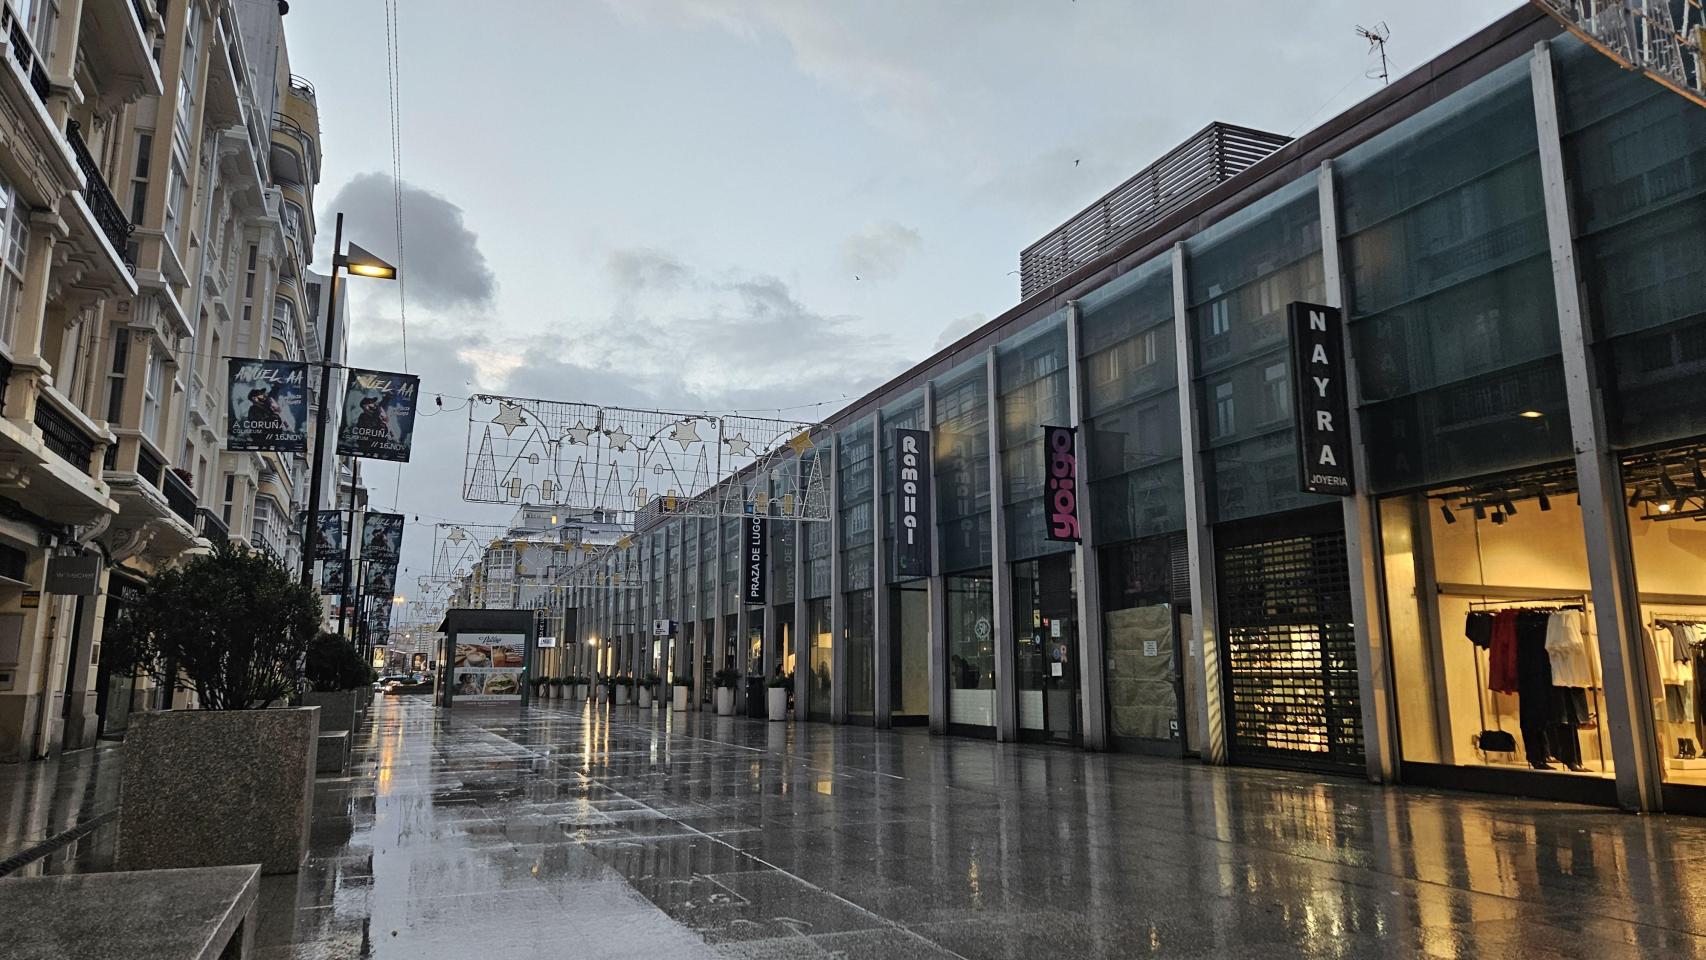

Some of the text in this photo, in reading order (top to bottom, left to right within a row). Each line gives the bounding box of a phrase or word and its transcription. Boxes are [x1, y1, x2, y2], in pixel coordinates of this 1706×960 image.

[285, 369, 303, 384] AA
[397, 382, 414, 397] AA
[1309, 310, 1337, 466] NAYRA
[233, 419, 286, 429] A CORUÑA
[352, 427, 392, 439] CORUÑA
[1051, 428, 1079, 539] yoigo
[1311, 475, 1348, 487] JOYERIA
[902, 436, 920, 545] Ramallal
[751, 515, 761, 597] PRAZA DE LUGO
